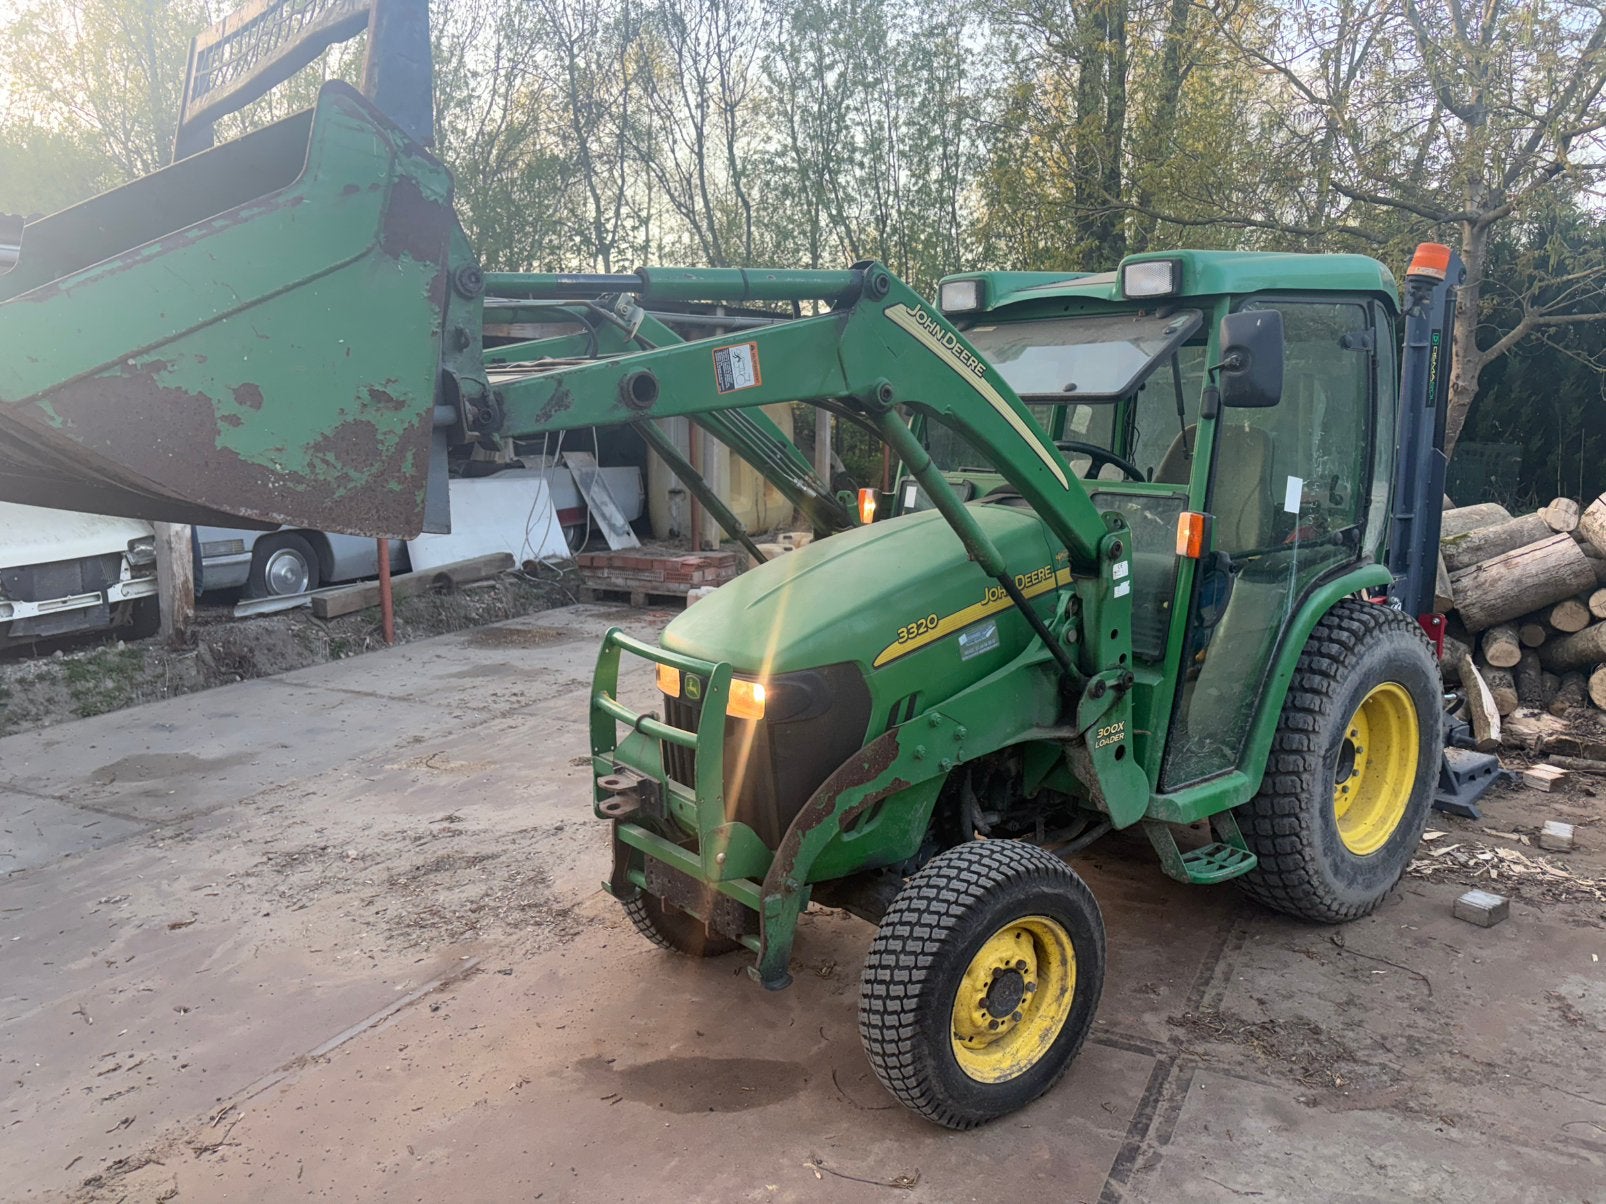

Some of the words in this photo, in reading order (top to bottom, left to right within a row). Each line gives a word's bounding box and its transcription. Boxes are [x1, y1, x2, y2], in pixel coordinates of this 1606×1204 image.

[906, 304, 944, 341] JOHN
[942, 331, 986, 378] DEERE
[981, 586, 1008, 605] JOH
[1015, 565, 1052, 590] DEERE
[897, 613, 938, 643] 3320
[1095, 732, 1125, 749] LOADER
[1097, 721, 1125, 739] 300X
